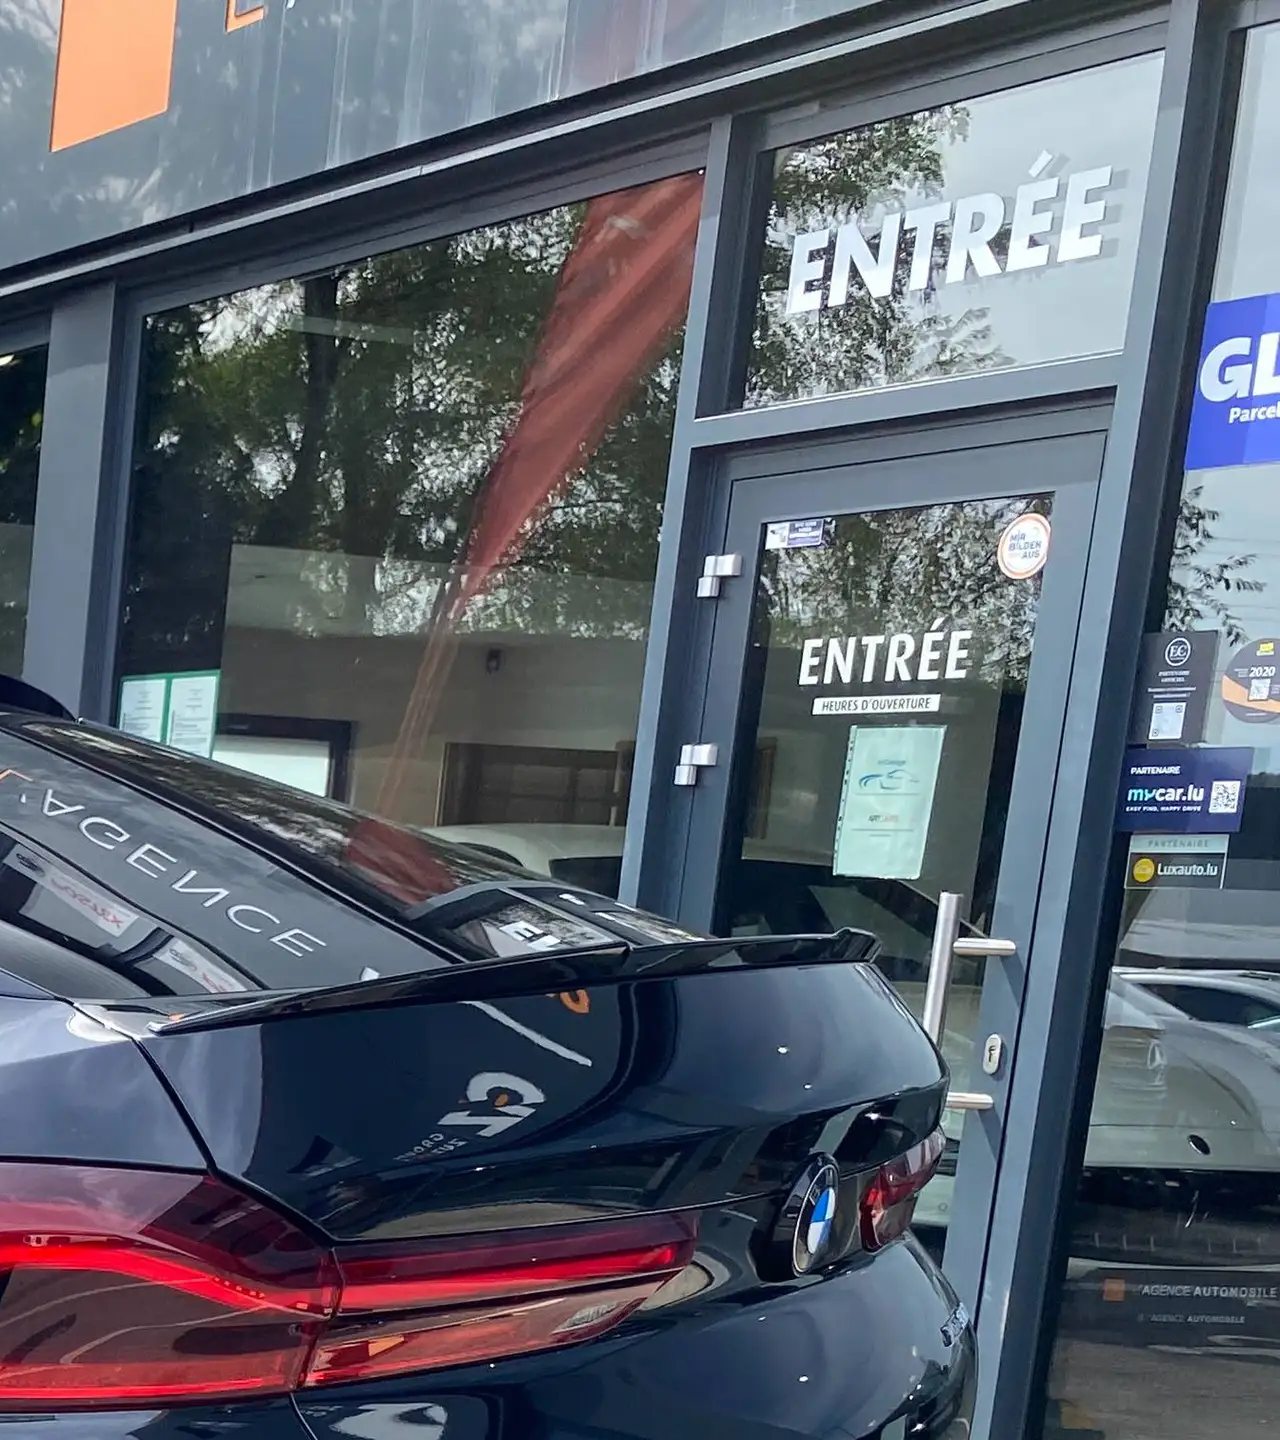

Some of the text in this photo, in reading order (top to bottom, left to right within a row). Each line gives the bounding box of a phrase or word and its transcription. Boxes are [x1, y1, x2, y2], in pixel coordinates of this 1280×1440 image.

[786, 149, 1113, 314] ENTRÉE
[798, 616, 973, 686] ENTRÉE
[1248, 665, 1277, 678] 2020
[821, 696, 932, 712] HEURES D'OUVERTURE
[1130, 765, 1181, 775] PARTENAIRE
[1127, 784, 1205, 802] mycar.lu
[1147, 839, 1209, 849] PARTENAIRE
[1157, 862, 1218, 876] Luxauto.lu
